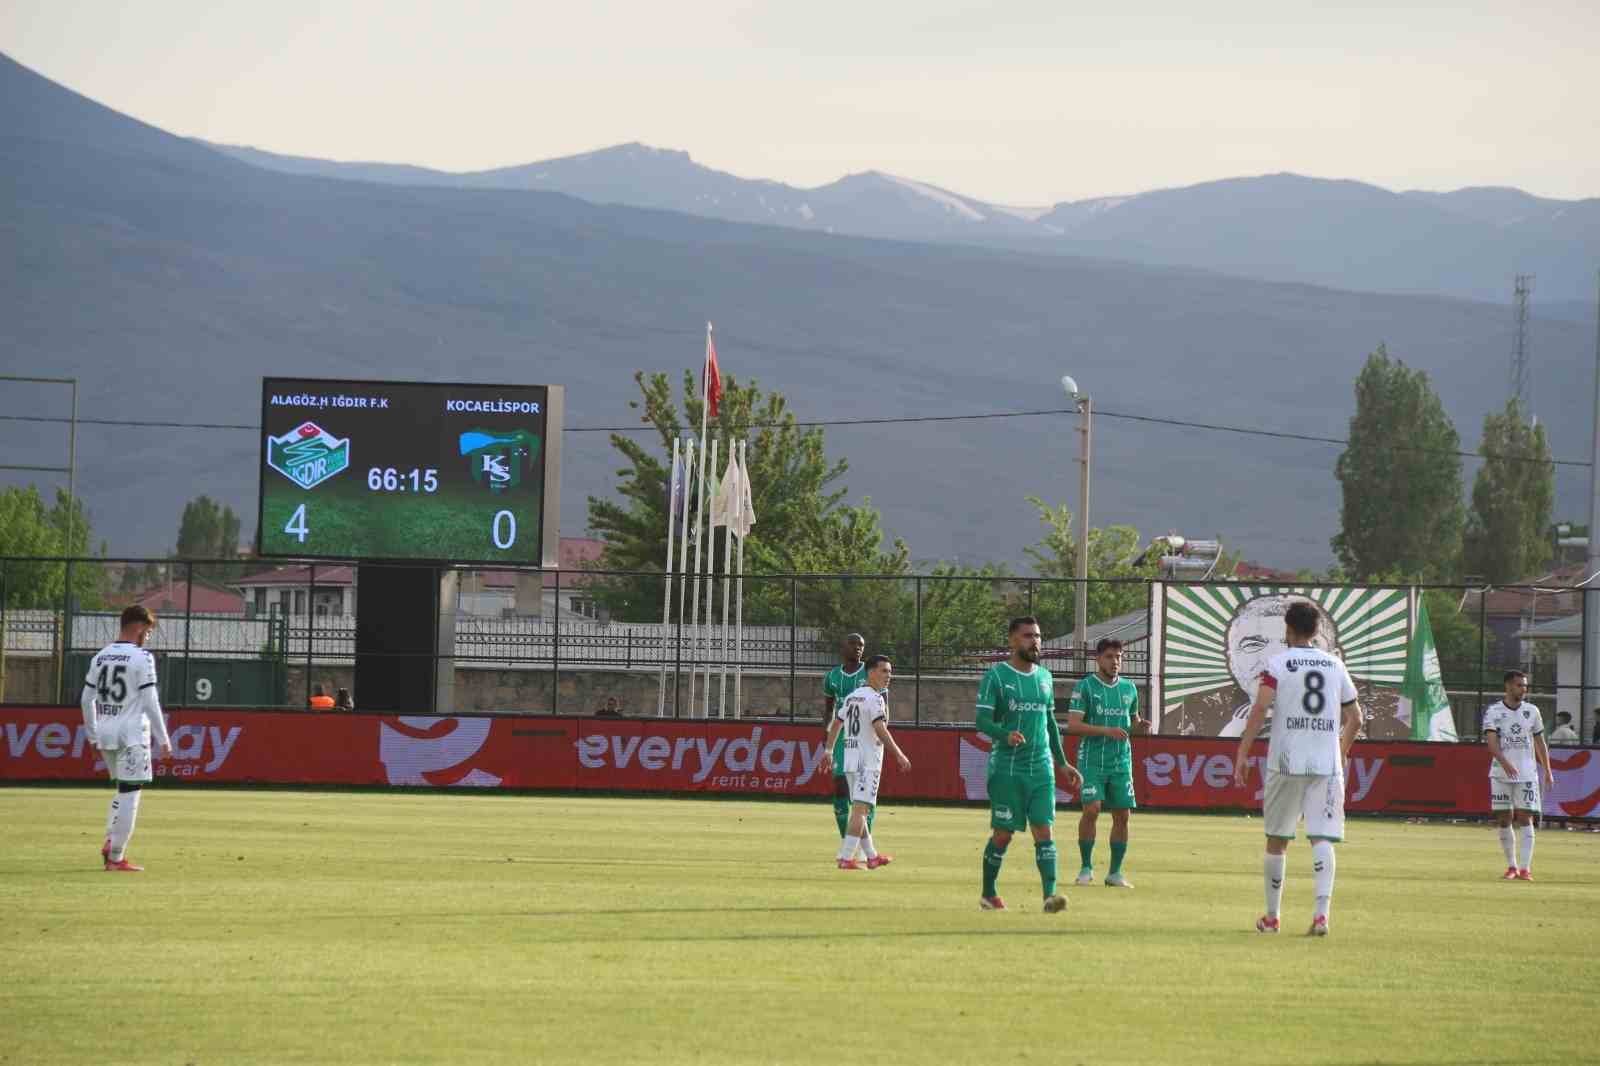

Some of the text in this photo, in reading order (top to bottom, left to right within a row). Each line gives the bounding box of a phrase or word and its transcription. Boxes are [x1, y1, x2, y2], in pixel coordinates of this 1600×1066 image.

[370, 398, 388, 408] F.K
[446, 398, 540, 413] KOCAELİSPOR
[368, 466, 438, 492] 66:15
[284, 503, 309, 543] 4
[492, 510, 516, 549] 0
[97, 664, 127, 703] 45
[195, 678, 212, 700] 9
[1302, 670, 1325, 715] 8
[1017, 702, 1047, 711] SOCA
[846, 703, 860, 737] 18
[573, 726, 825, 784] everyday
[172, 764, 199, 777] car
[711, 775, 790, 789] rent a car
[1523, 789, 1535, 801] 70
